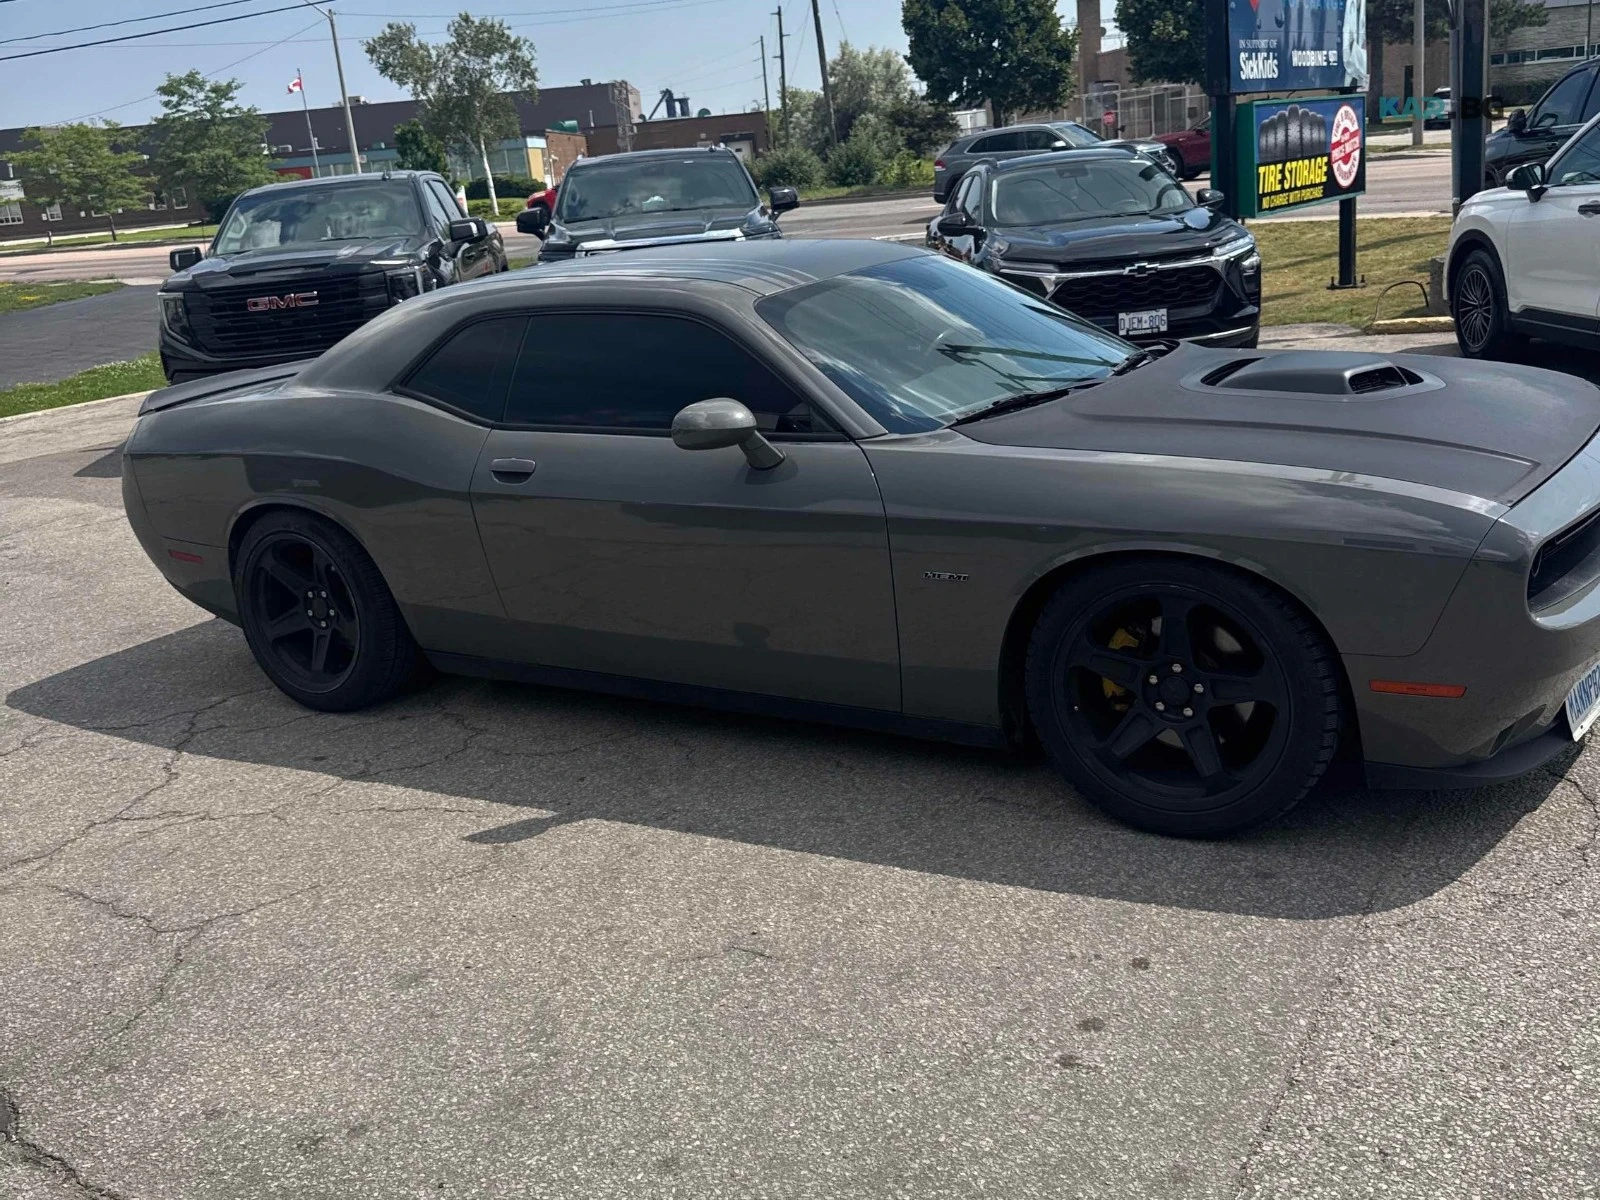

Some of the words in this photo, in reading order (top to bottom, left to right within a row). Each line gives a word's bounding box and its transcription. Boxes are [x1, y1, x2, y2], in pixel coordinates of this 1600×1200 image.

[1239, 40, 1246, 49] IN
[1246, 40, 1269, 49] SUPPORT
[1269, 39, 1278, 48] OF
[1240, 52, 1278, 80] SickKids
[1292, 50, 1327, 67] WOODBINE
[1258, 163, 1282, 194] TIRE
[1284, 157, 1328, 189] STORAGE
[1262, 197, 1270, 209] NO
[1270, 193, 1288, 208] CHARGE
[1289, 191, 1300, 204] WITH
[1300, 186, 1323, 201] PURCHASE
[247, 291, 319, 311] GMC
